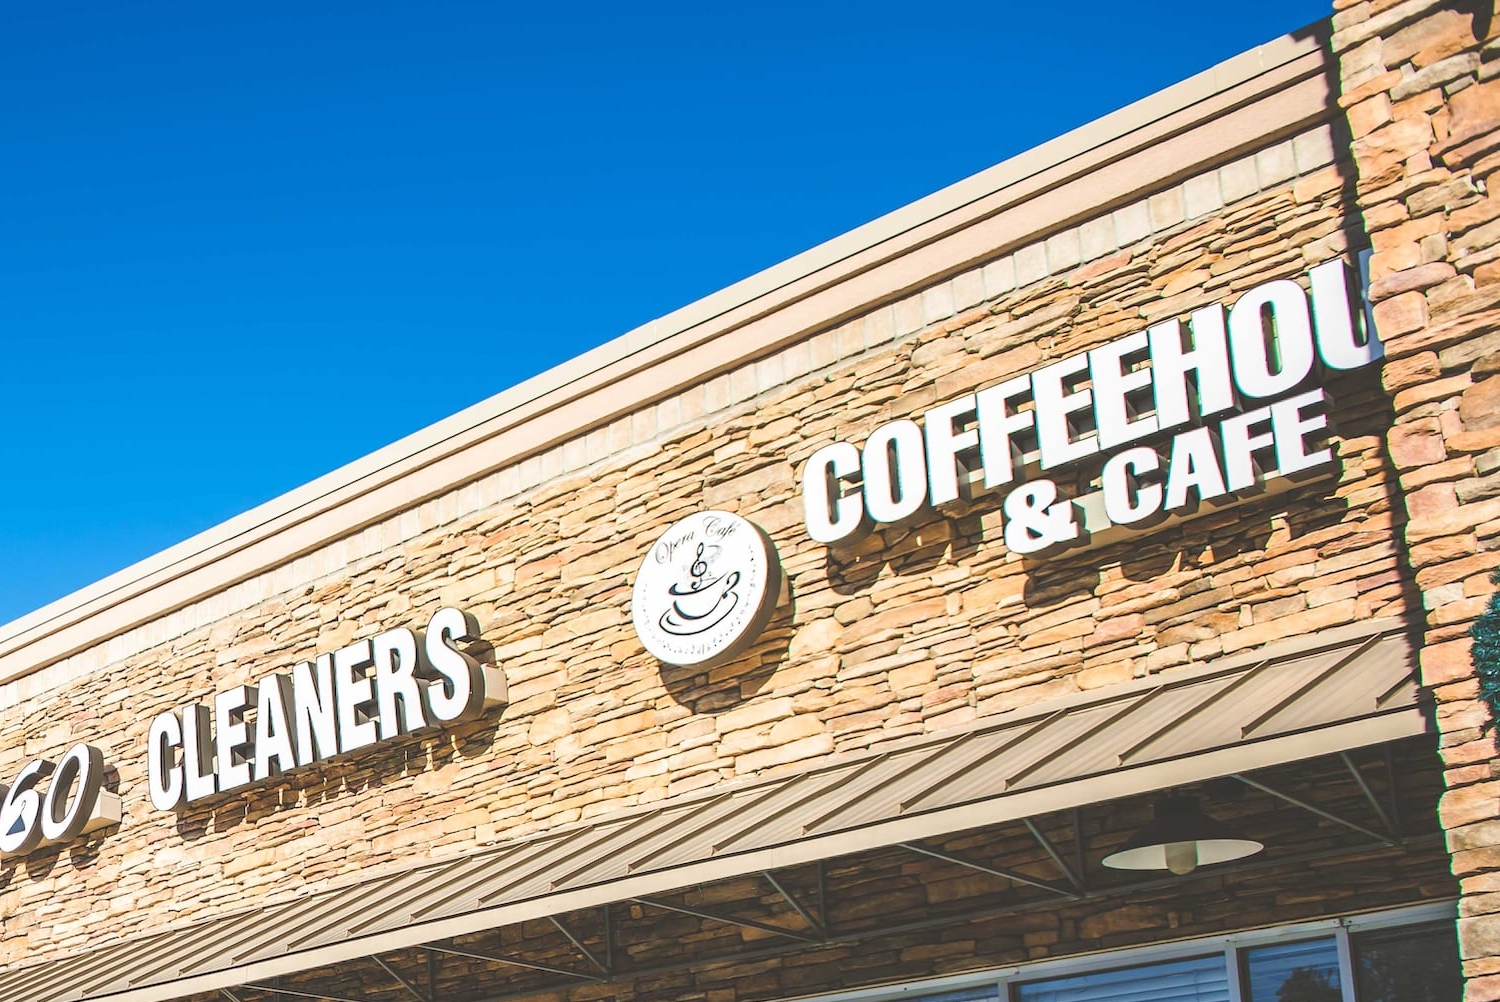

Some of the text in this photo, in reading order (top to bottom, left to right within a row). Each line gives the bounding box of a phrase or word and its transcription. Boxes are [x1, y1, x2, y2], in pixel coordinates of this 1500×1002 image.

[655, 531, 695, 565] Opera
[1003, 387, 1334, 555] & CAFE
[147, 606, 476, 812] CLEANERS
